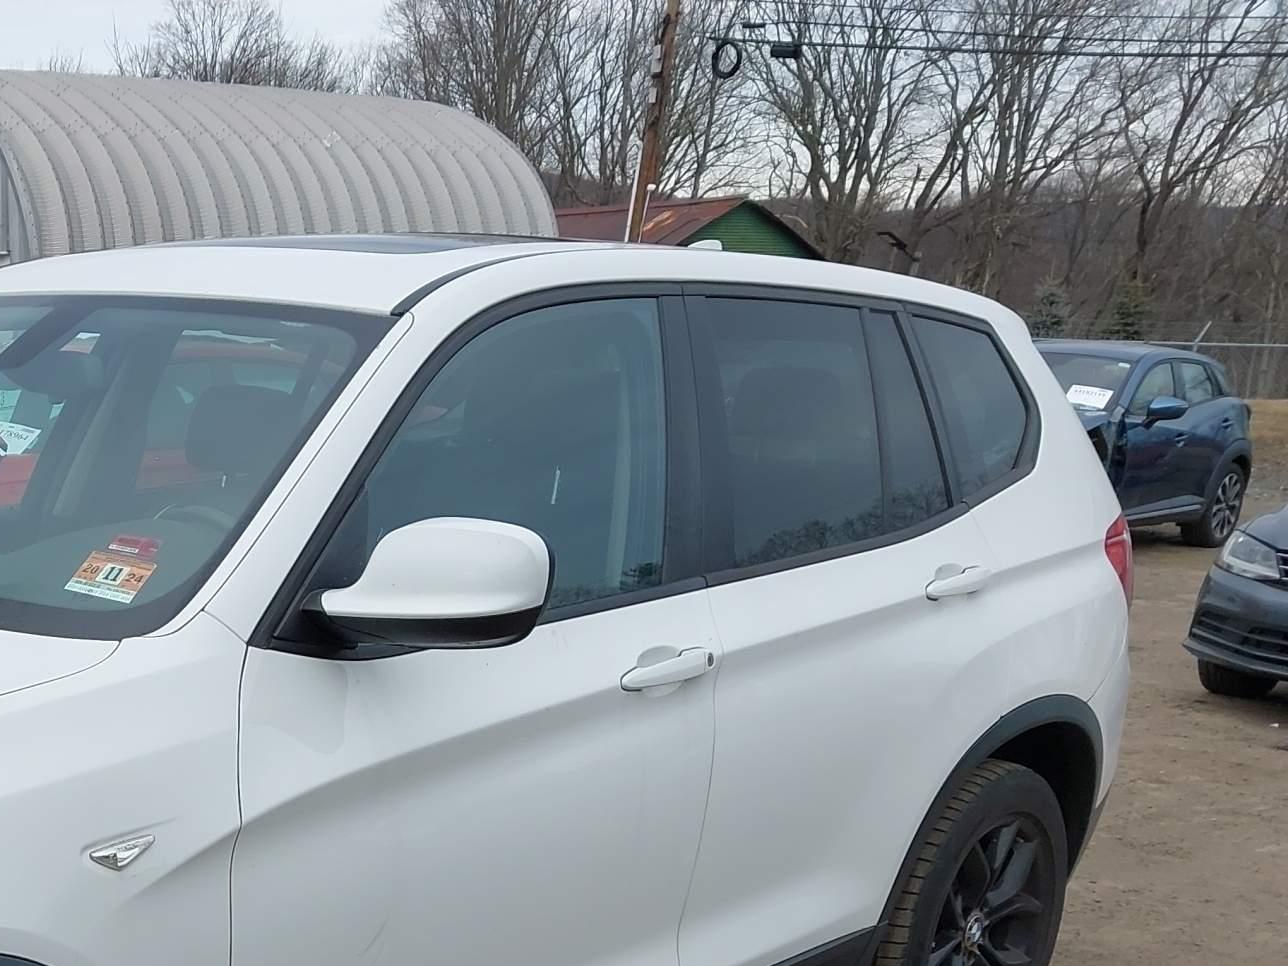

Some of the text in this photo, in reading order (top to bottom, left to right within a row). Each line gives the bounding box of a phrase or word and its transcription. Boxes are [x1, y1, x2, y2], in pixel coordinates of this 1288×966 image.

[82, 563, 145, 585] 20 11 24
